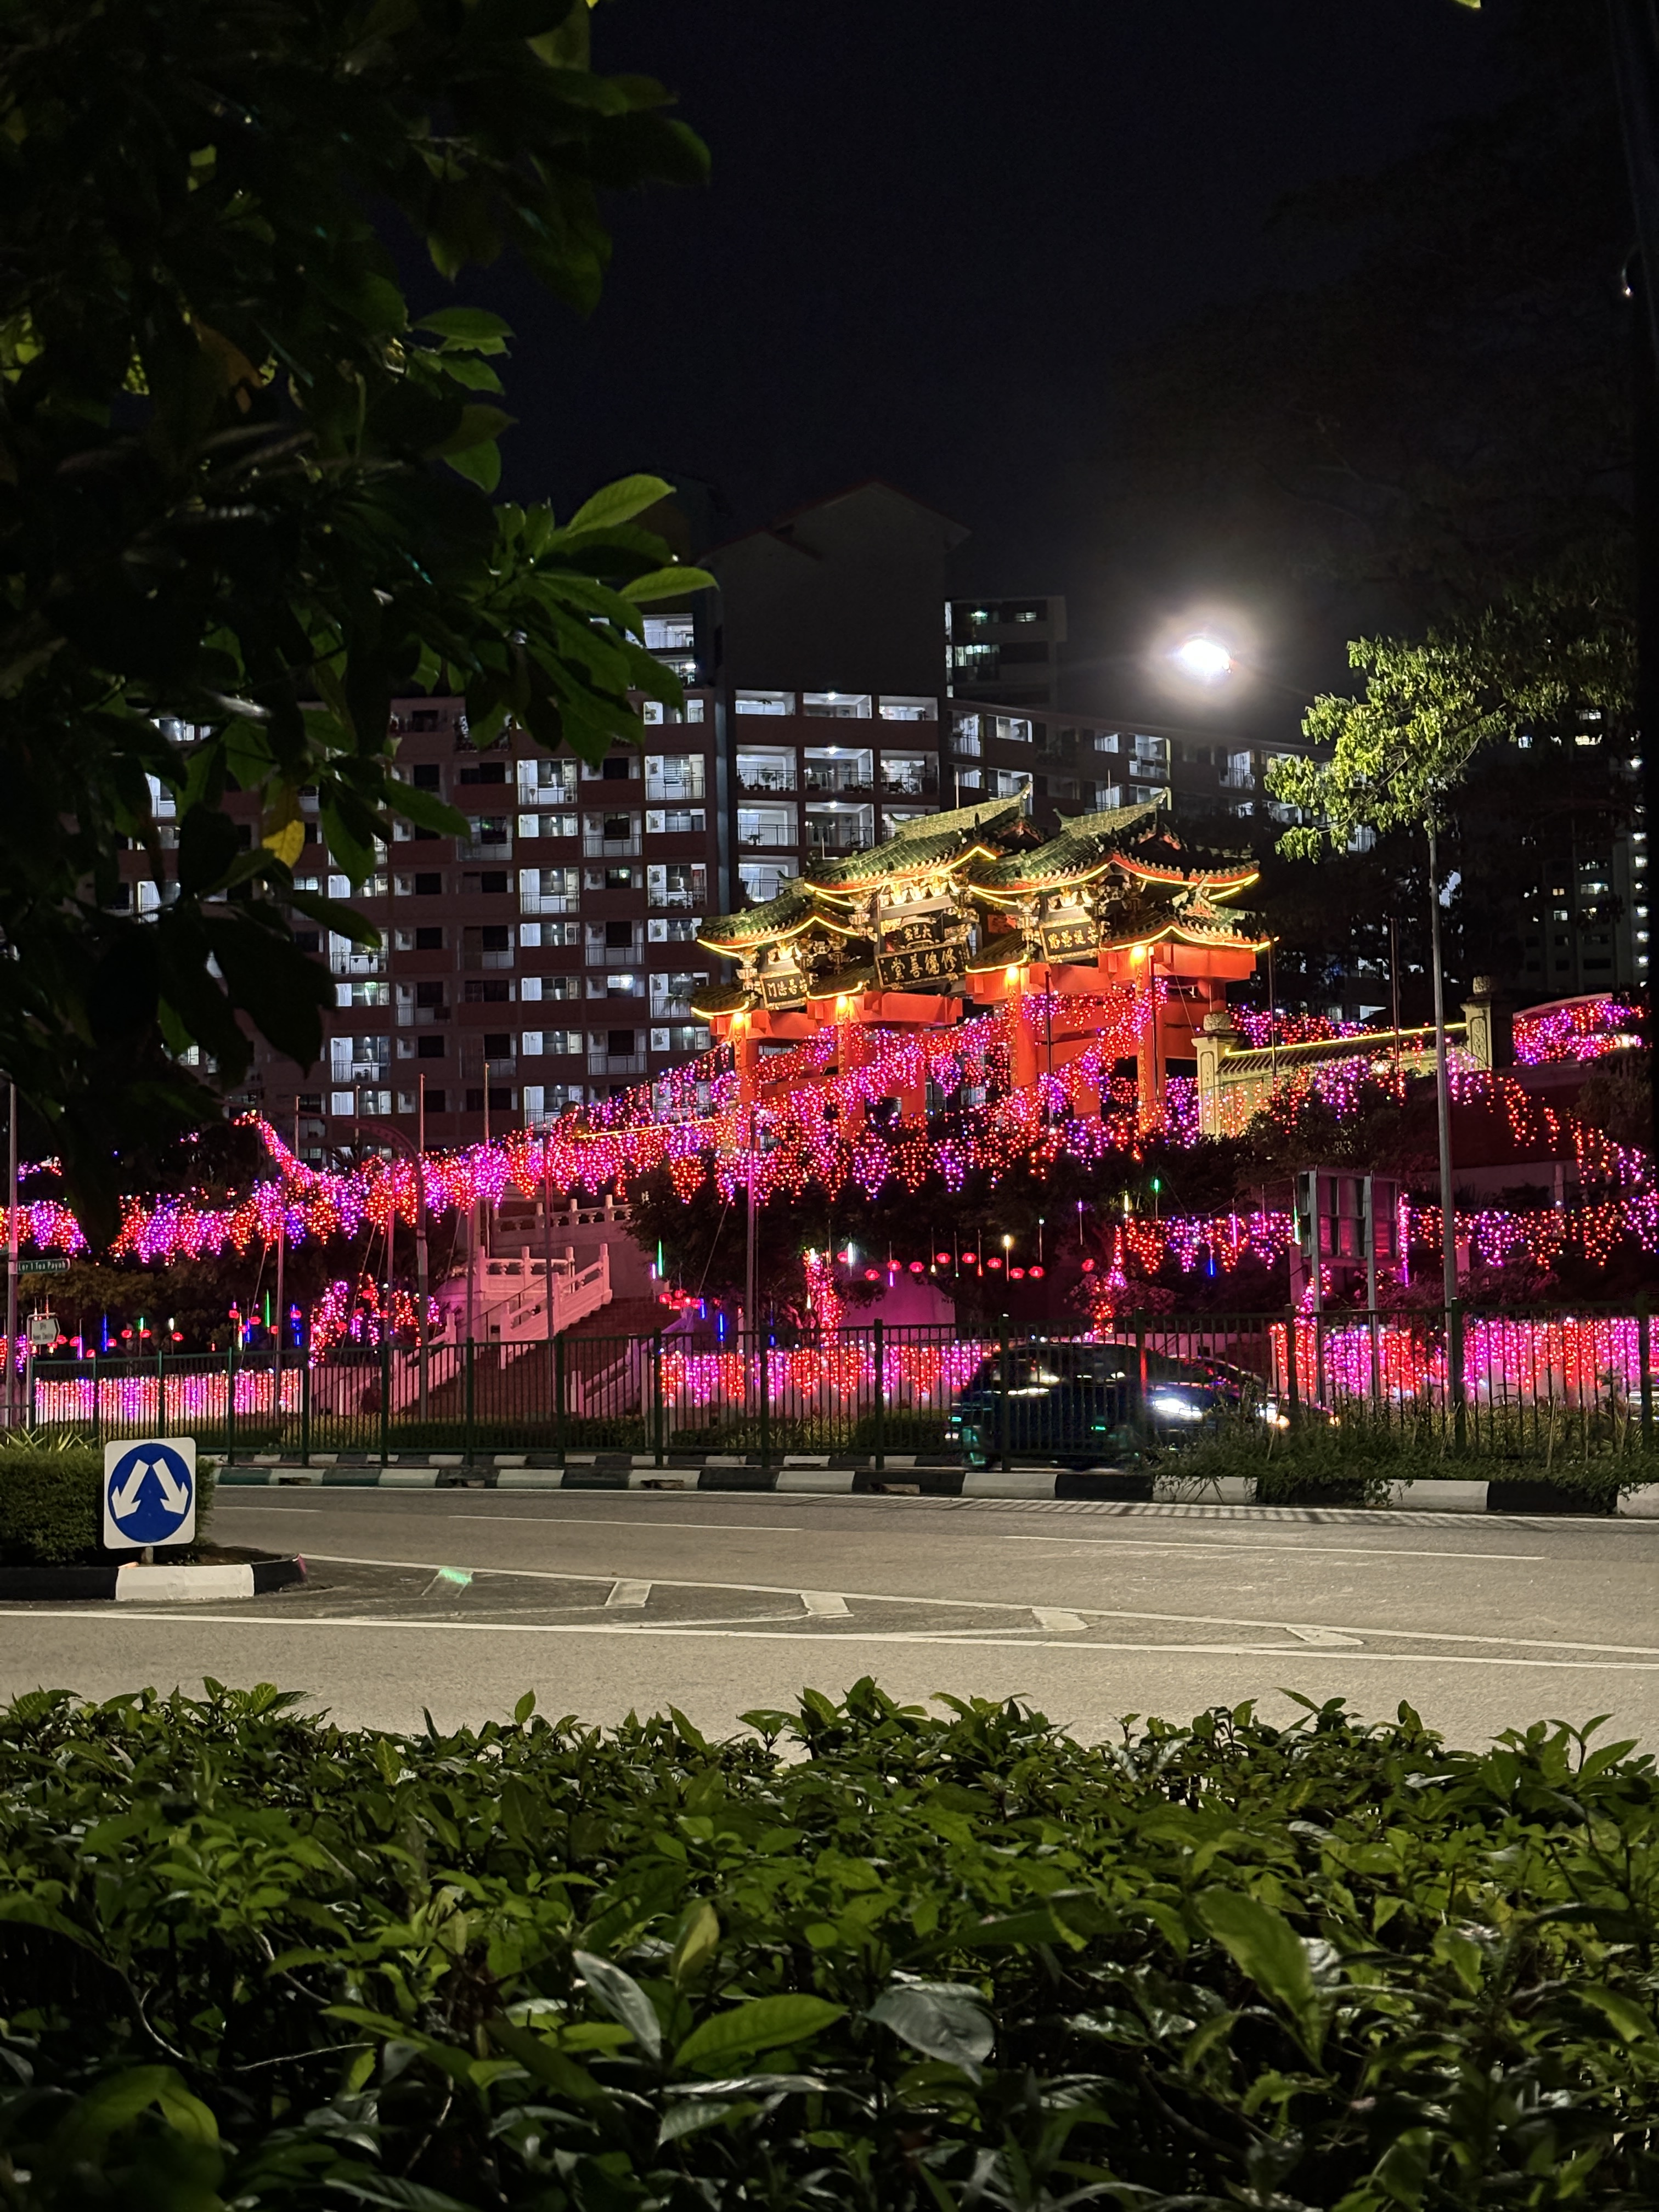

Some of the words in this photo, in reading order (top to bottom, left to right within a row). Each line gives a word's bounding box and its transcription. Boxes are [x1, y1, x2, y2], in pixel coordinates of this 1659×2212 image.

[19, 1262, 29, 1272] Lor
[36, 1262, 46, 1271] Toa
[48, 1261, 66, 1271] Payoh
